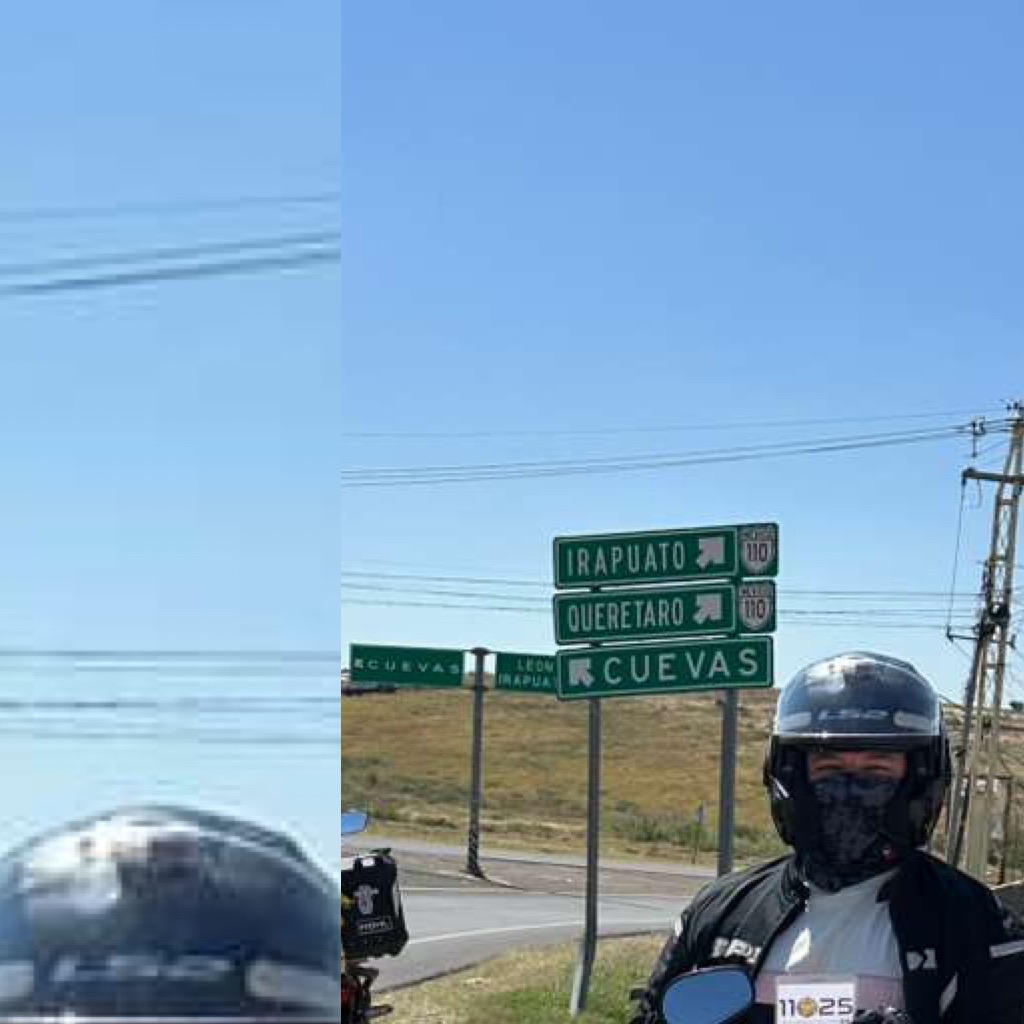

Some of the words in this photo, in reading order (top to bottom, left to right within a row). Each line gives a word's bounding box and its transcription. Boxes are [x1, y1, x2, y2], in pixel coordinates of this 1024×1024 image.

[567, 541, 685, 577] IRAPUATO
[747, 542, 768, 561] 110
[567, 597, 684, 632] QUERETARO
[744, 599, 765, 619] 110
[498, 672, 557, 689] IRAPUA
[604, 647, 759, 684] CUEVAS
